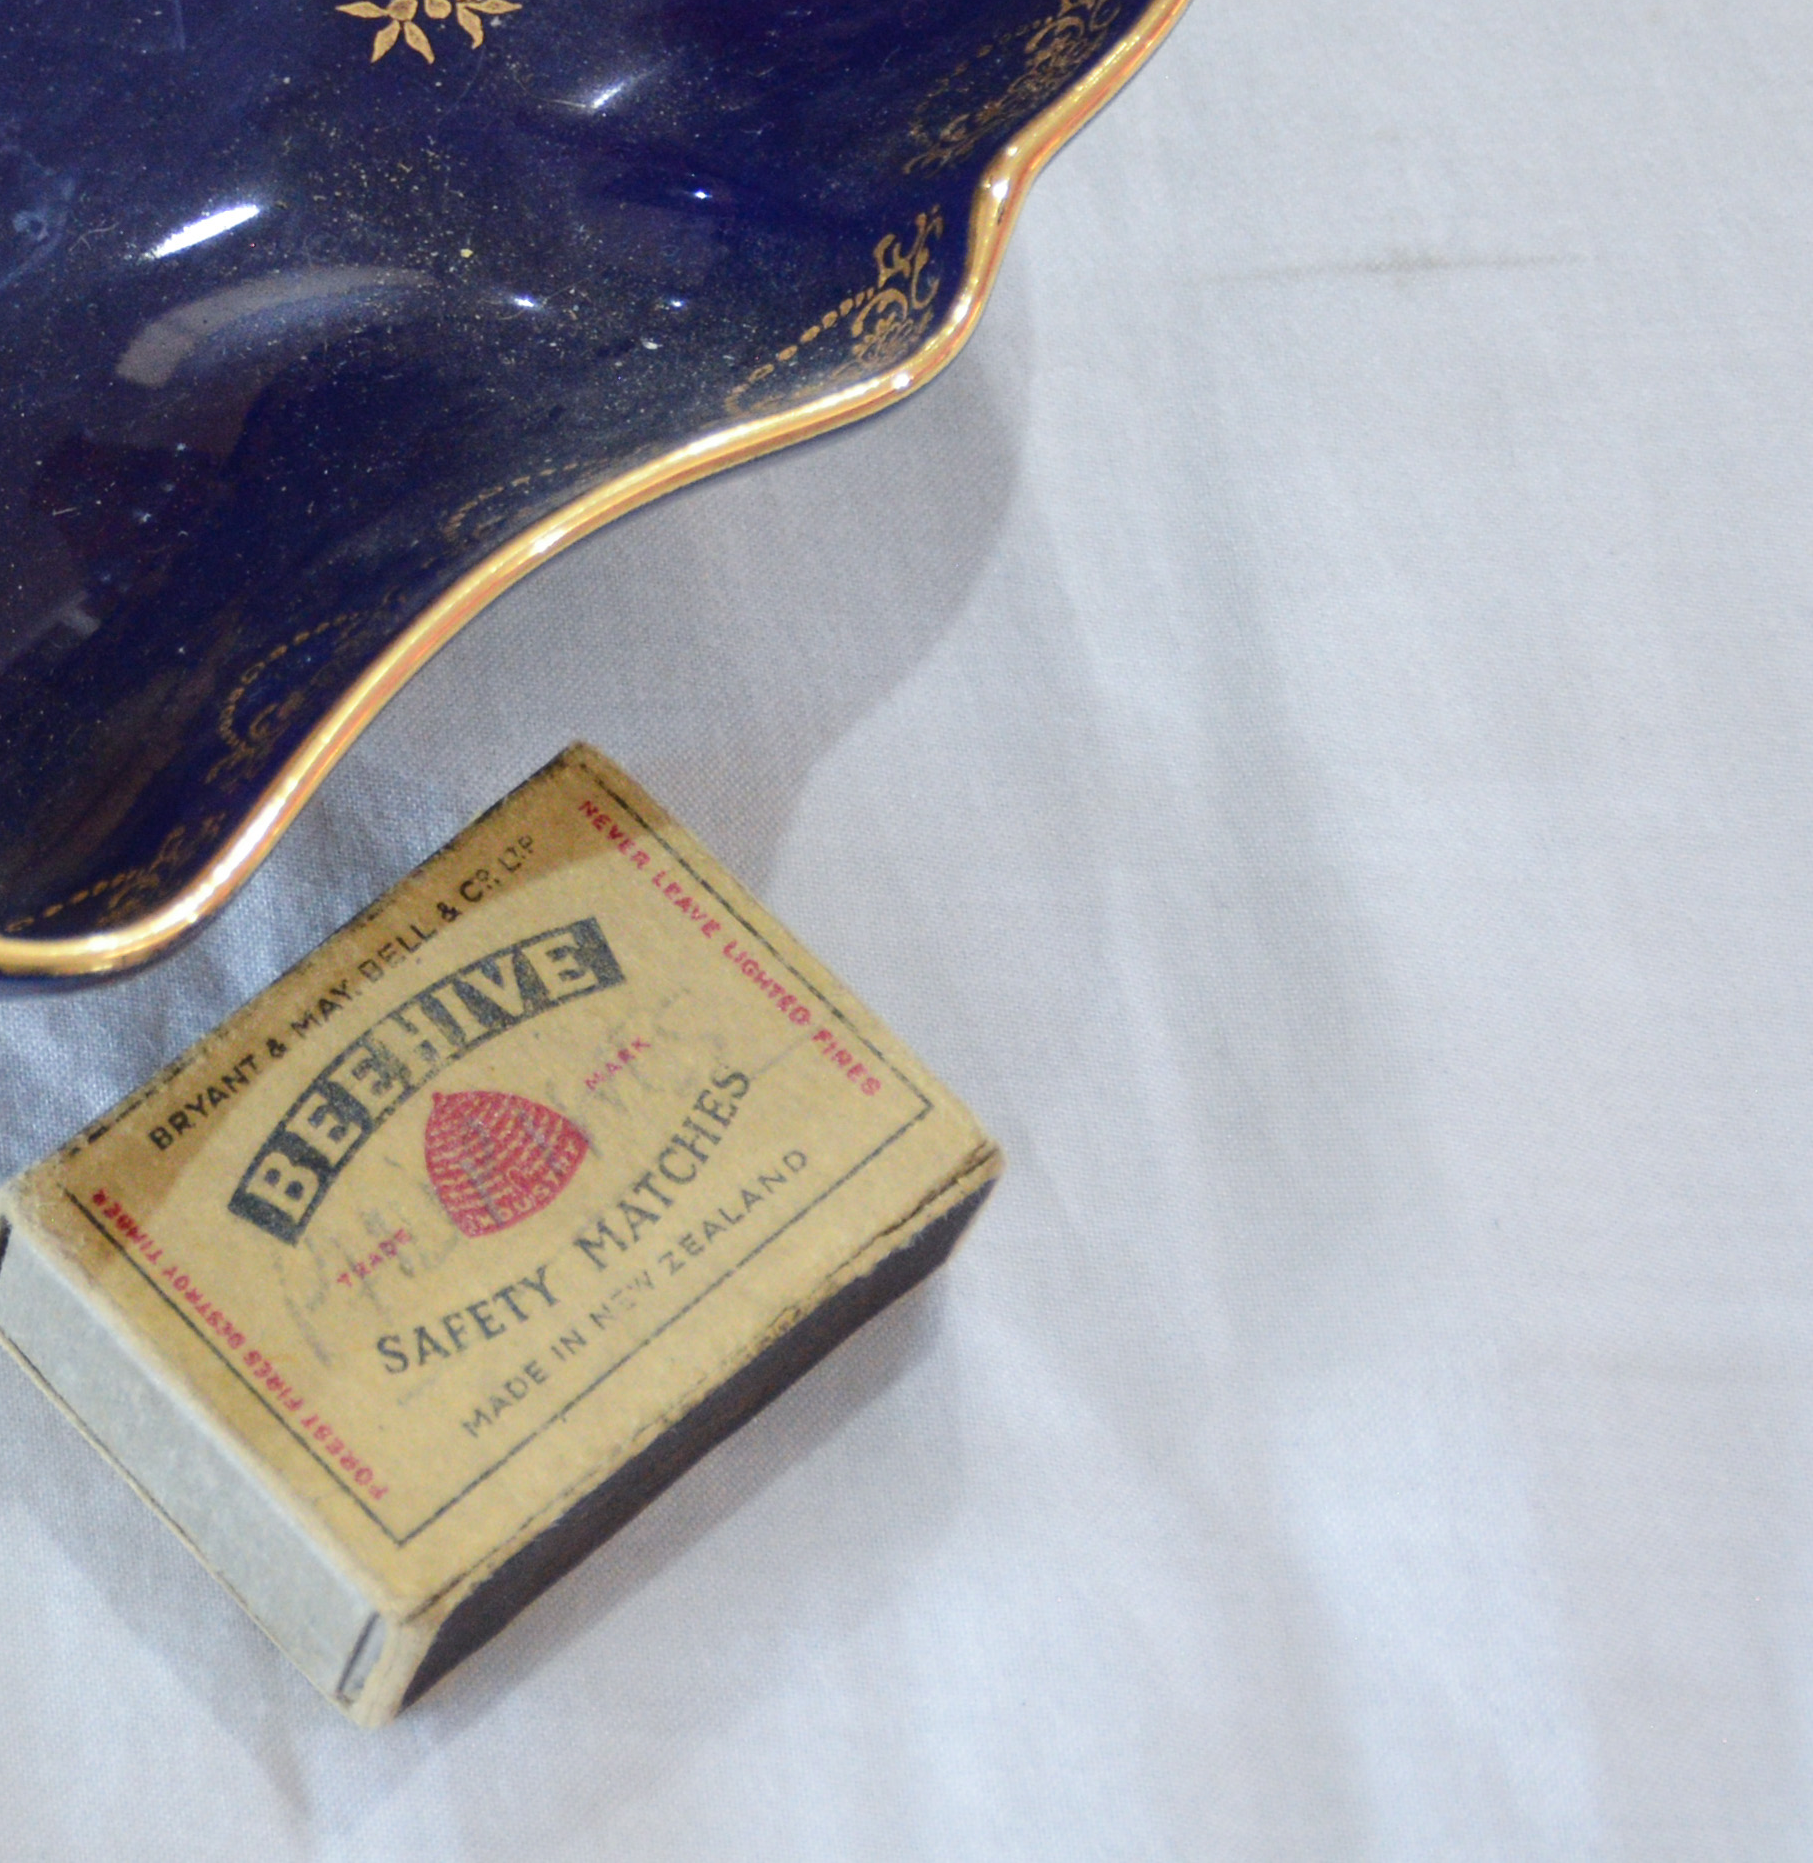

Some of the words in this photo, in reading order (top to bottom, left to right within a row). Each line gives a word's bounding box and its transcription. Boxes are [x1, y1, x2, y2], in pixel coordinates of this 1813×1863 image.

[149, 1052, 259, 1150] BRYANT
[269, 1038, 287, 1058] &
[436, 901, 459, 922] &
[245, 928, 601, 1230] BEEHIVE
[578, 800, 651, 870] NEVER
[652, 870, 721, 939] LEAVE
[723, 939, 811, 1026] LIGHTED
[812, 1028, 882, 1096] FIRES
[336, 1228, 412, 1288] TRADE
[584, 1036, 651, 1091] MARK
[375, 1264, 560, 1375] SAFETY
[573, 1066, 752, 1271] MATCHES
[462, 1360, 549, 1439] MADE
[550, 1329, 587, 1362] IN
[587, 1270, 656, 1332] NEW
[656, 1148, 809, 1277] ZEALAND
[243, 1350, 304, 1413] FIRES
[300, 1414, 388, 1500] FOREST
